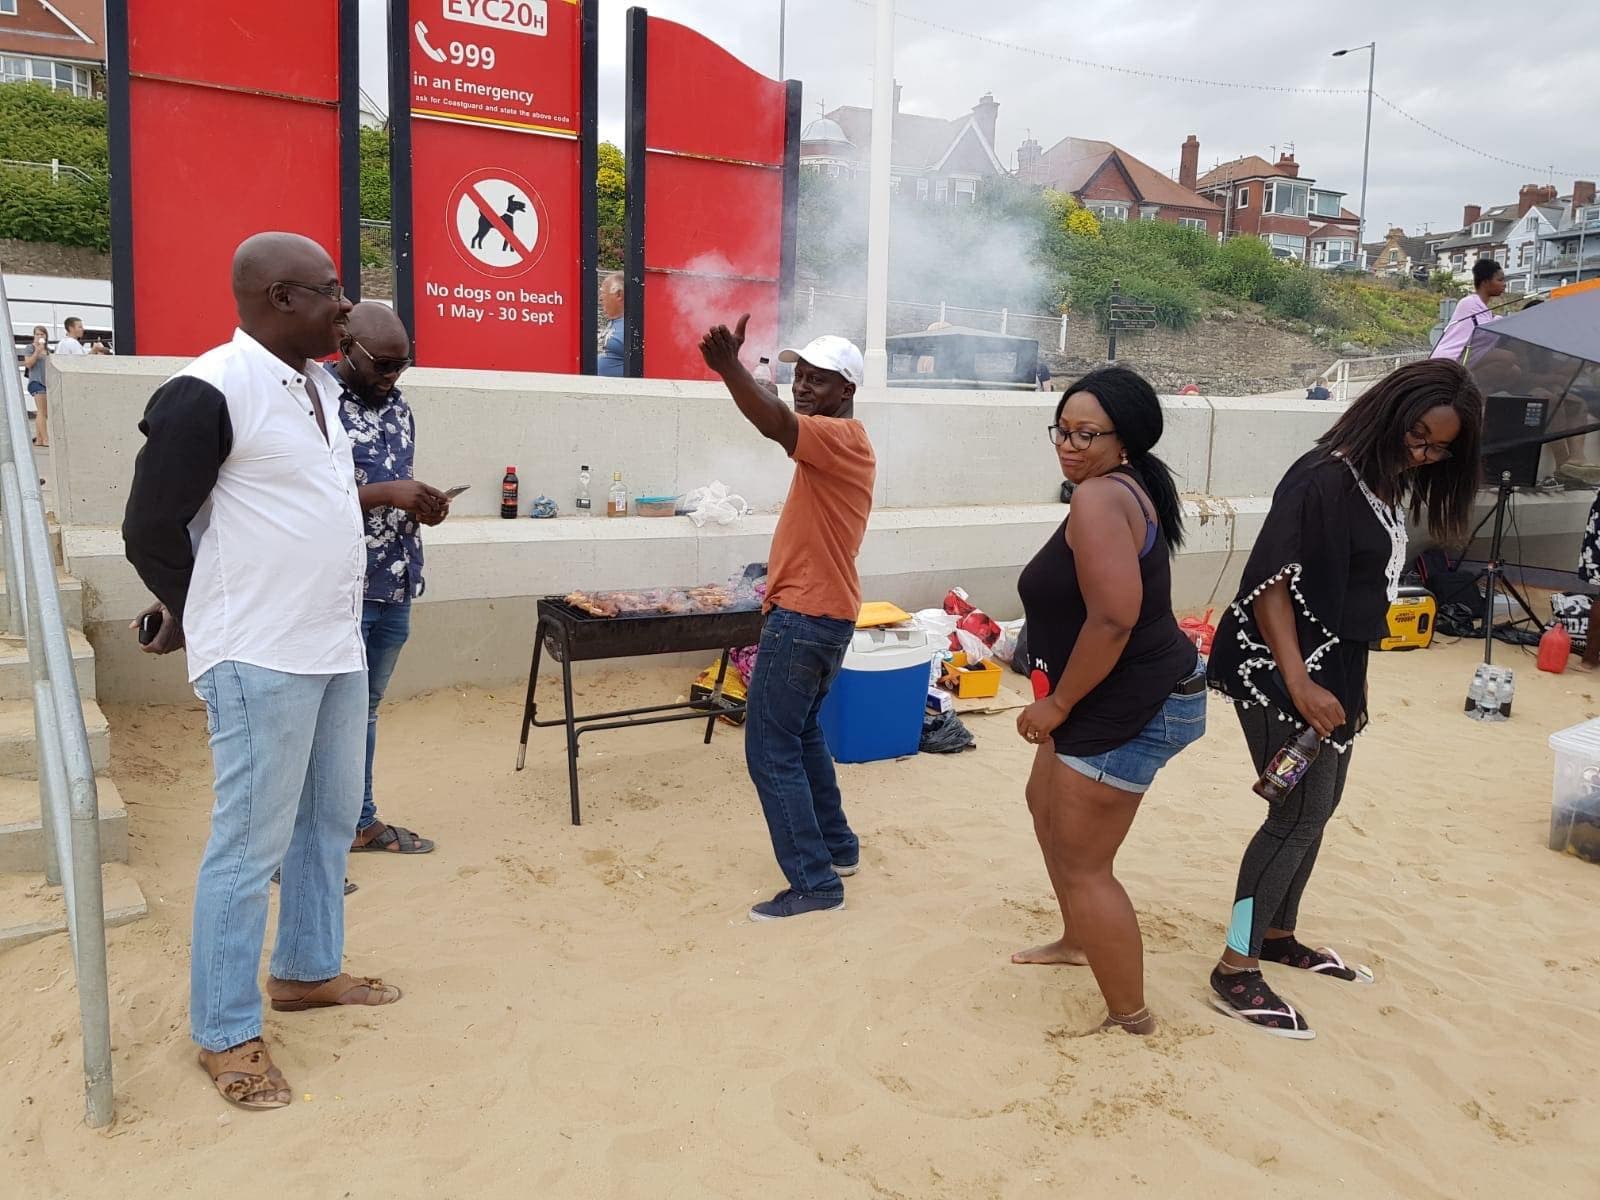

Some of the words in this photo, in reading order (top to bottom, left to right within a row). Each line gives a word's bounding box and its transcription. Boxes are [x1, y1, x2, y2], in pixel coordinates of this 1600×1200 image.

[449, 41, 496, 70] 999
[414, 71, 428, 87] in
[432, 77, 451, 90] an
[455, 78, 534, 106] Emergency
[430, 96, 441, 104] for
[443, 98, 483, 111] Coastguard
[500, 107, 517, 115] state
[519, 109, 530, 117] the
[532, 111, 552, 120] above
[553, 115, 570, 123] code
[426, 282, 449, 297] No
[454, 284, 491, 303] dogs
[496, 289, 515, 301] on
[520, 289, 563, 305] beach
[437, 303, 444, 317] 1
[451, 304, 484, 322] May
[499, 307, 517, 321] 30
[521, 309, 554, 325] Sept
